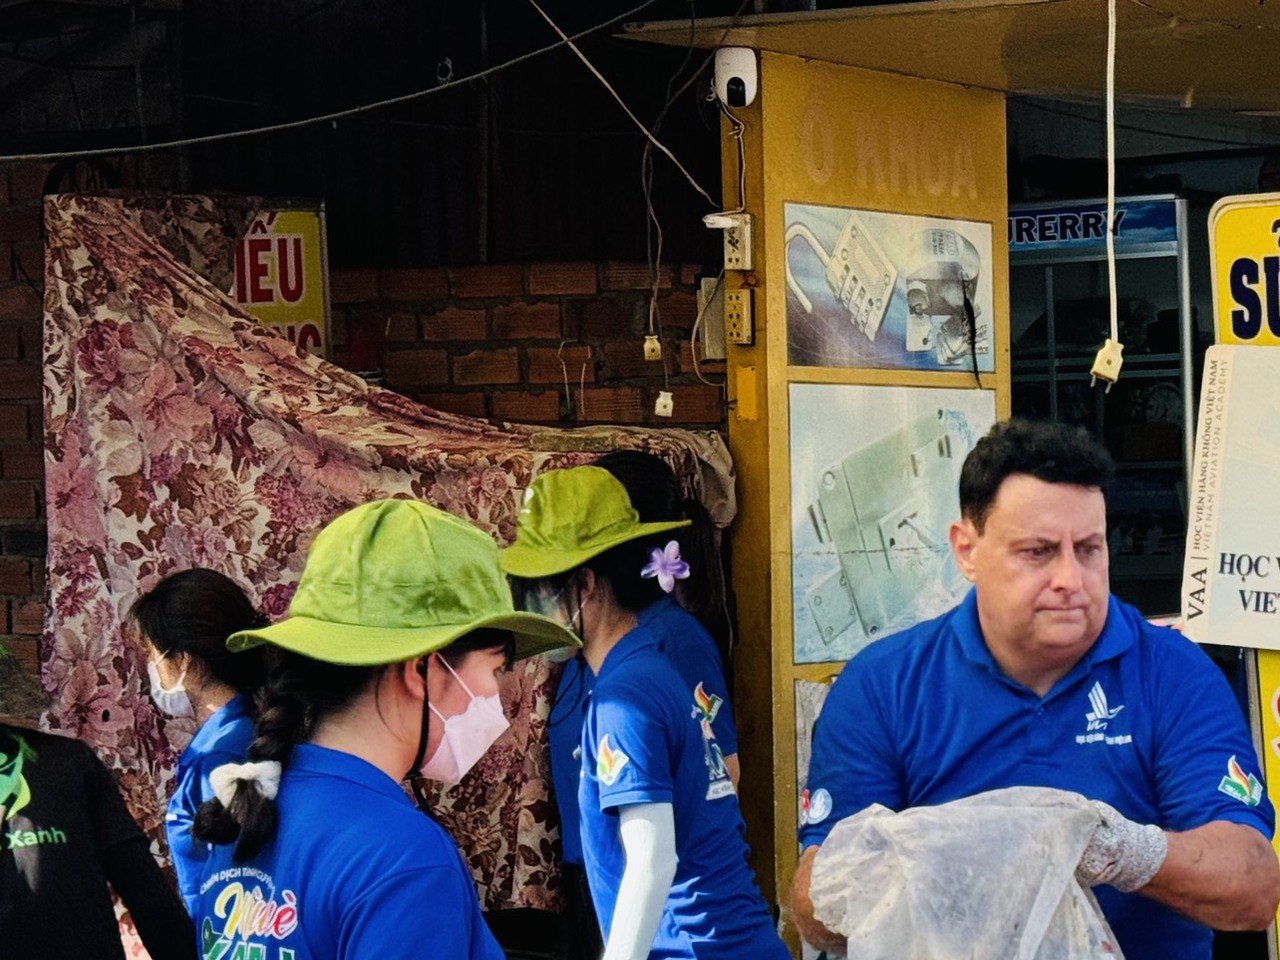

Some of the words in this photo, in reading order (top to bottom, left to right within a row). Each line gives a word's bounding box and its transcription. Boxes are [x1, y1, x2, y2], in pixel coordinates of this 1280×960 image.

[235, 211, 303, 303] IẾU
[1008, 209, 1128, 245] RERRY
[1187, 567, 1208, 621] VAA
[1209, 360, 1218, 384] NAM
[1203, 496, 1215, 551] VIETNAM
[1210, 427, 1221, 488] AVIATION
[1216, 360, 1229, 421] ACADEMY
[1218, 553, 1270, 582] HỌC
